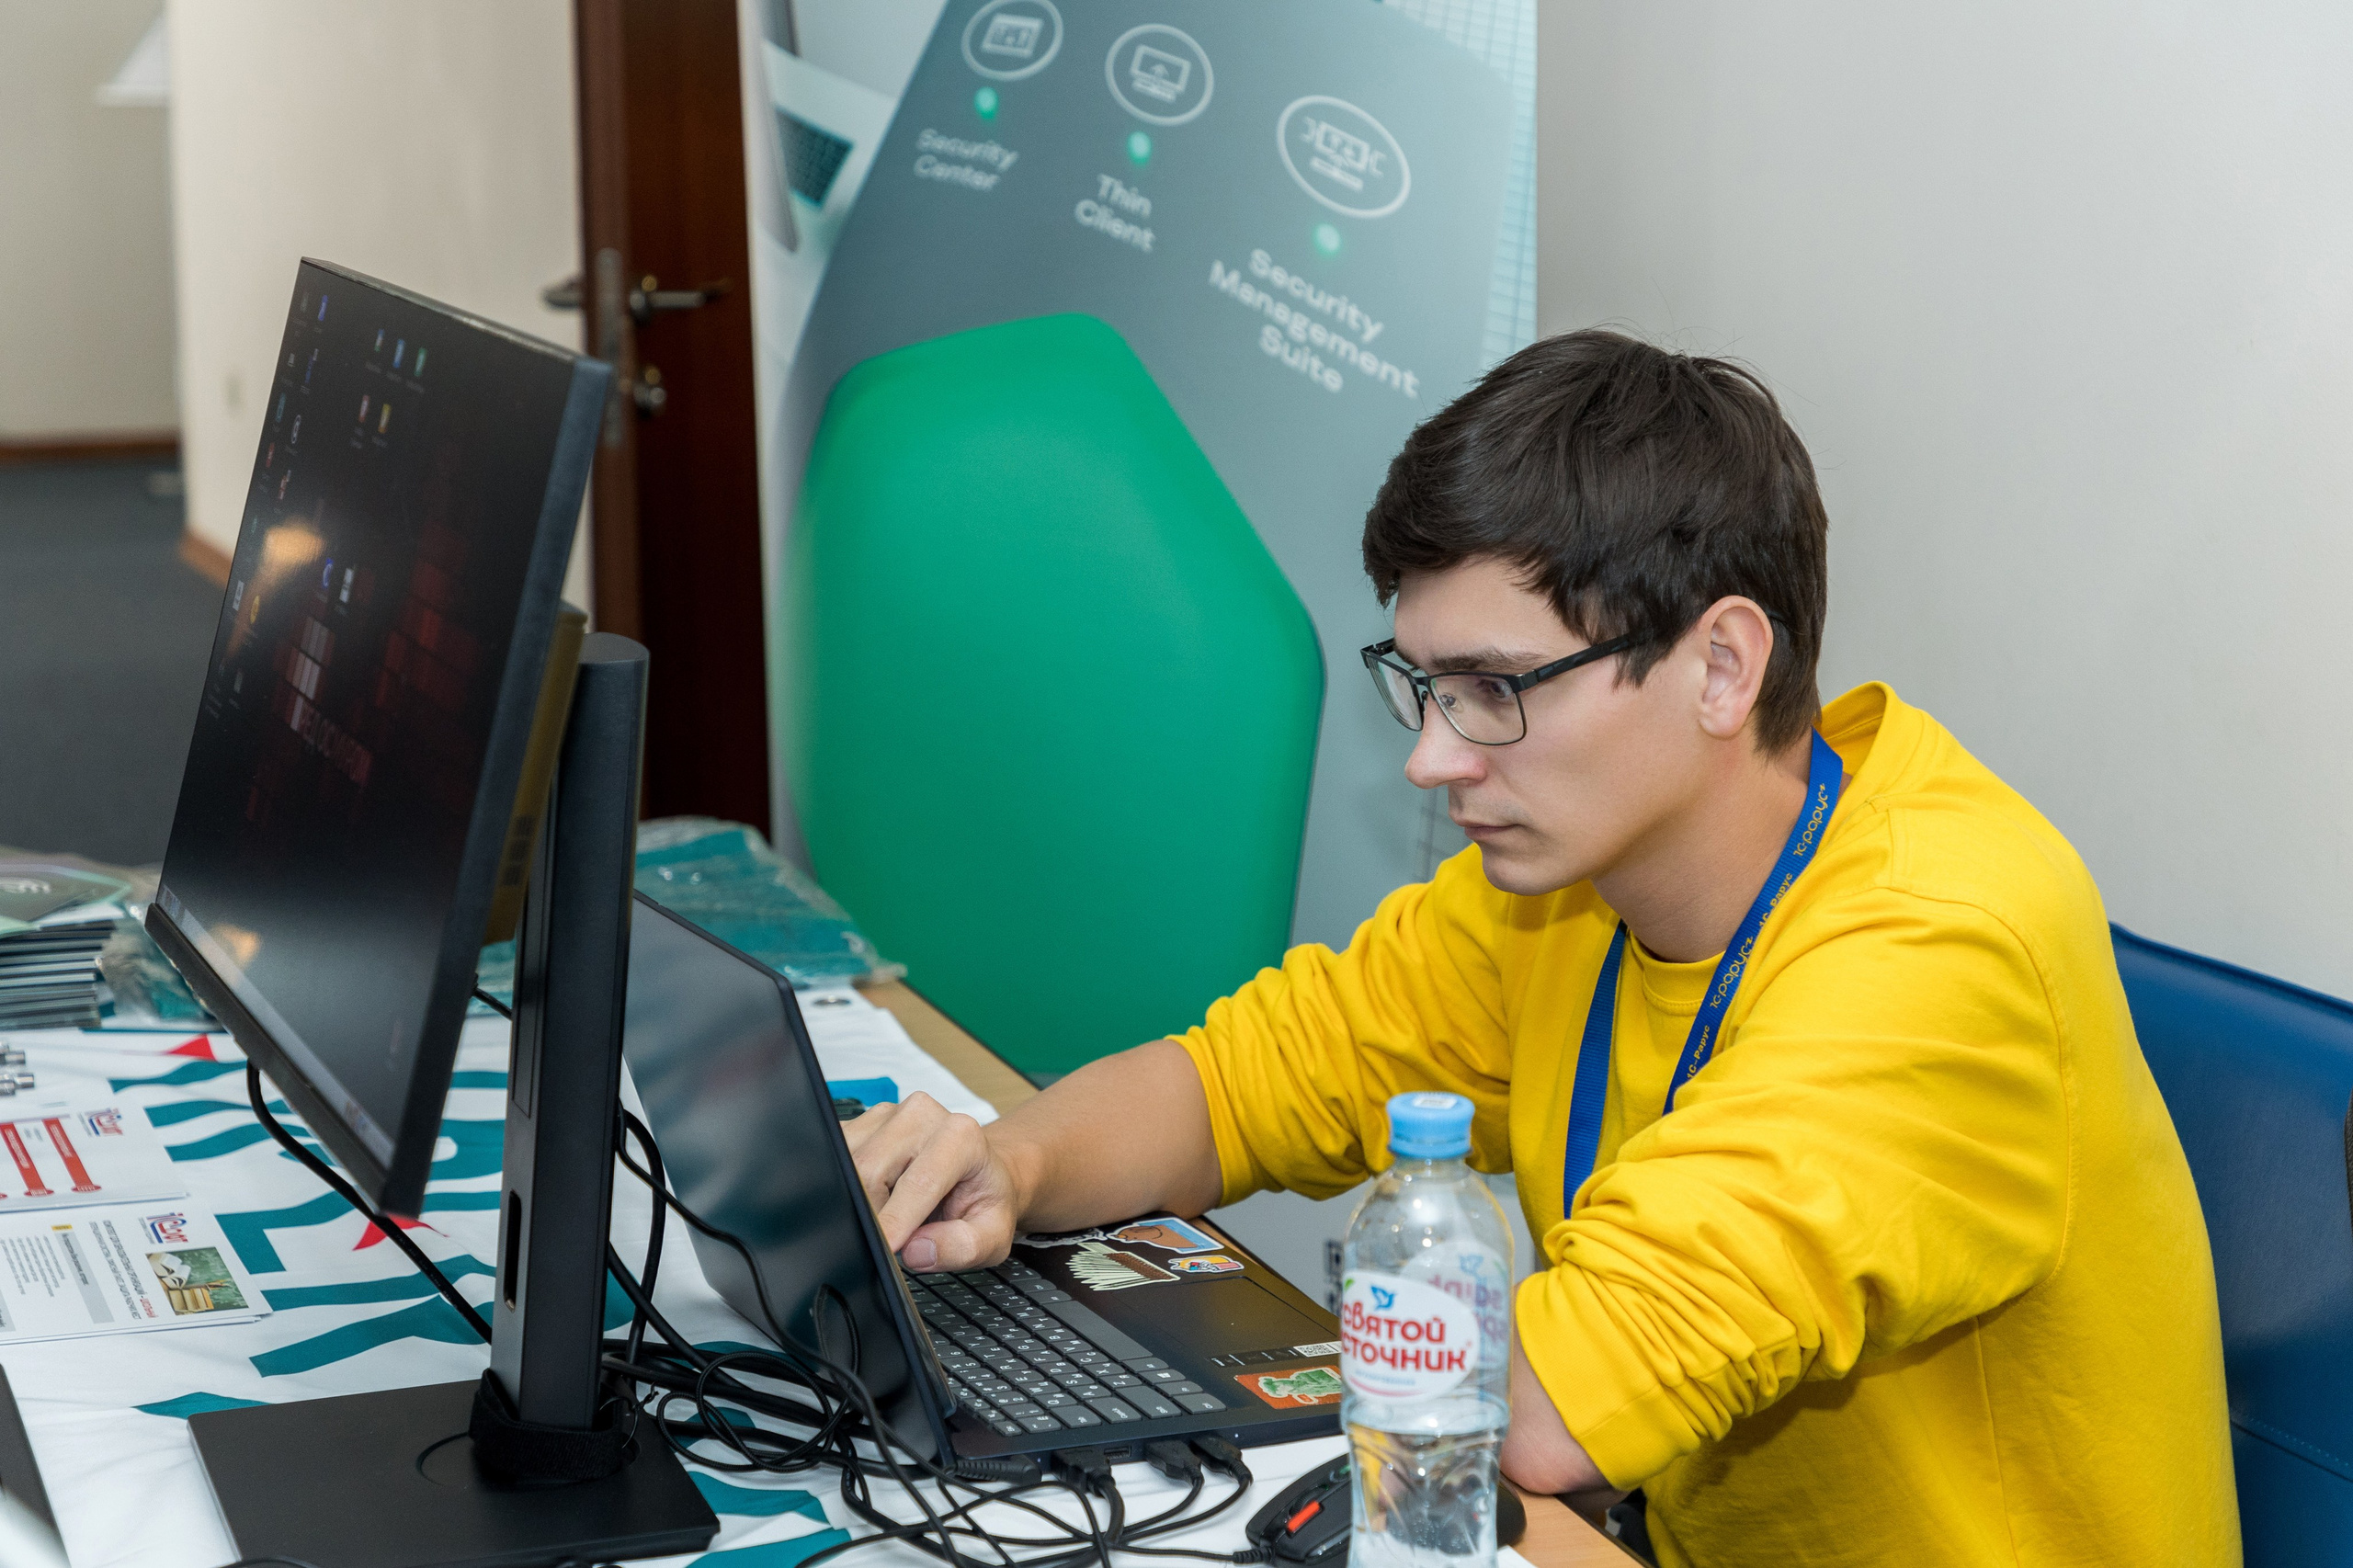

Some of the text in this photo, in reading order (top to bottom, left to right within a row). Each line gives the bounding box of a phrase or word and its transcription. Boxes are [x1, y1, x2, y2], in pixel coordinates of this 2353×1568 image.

[914, 154, 1000, 191] Center
[916, 128, 1018, 172] Security
[1097, 174, 1152, 217] Thin
[1074, 199, 1155, 252] Client
[1248, 248, 1384, 344] Security
[1209, 259, 1420, 399] Management
[1258, 324, 1344, 393] Suite
[1758, 872, 1793, 927] 1СРарус
[1342, 1330, 1467, 1372] сточник
